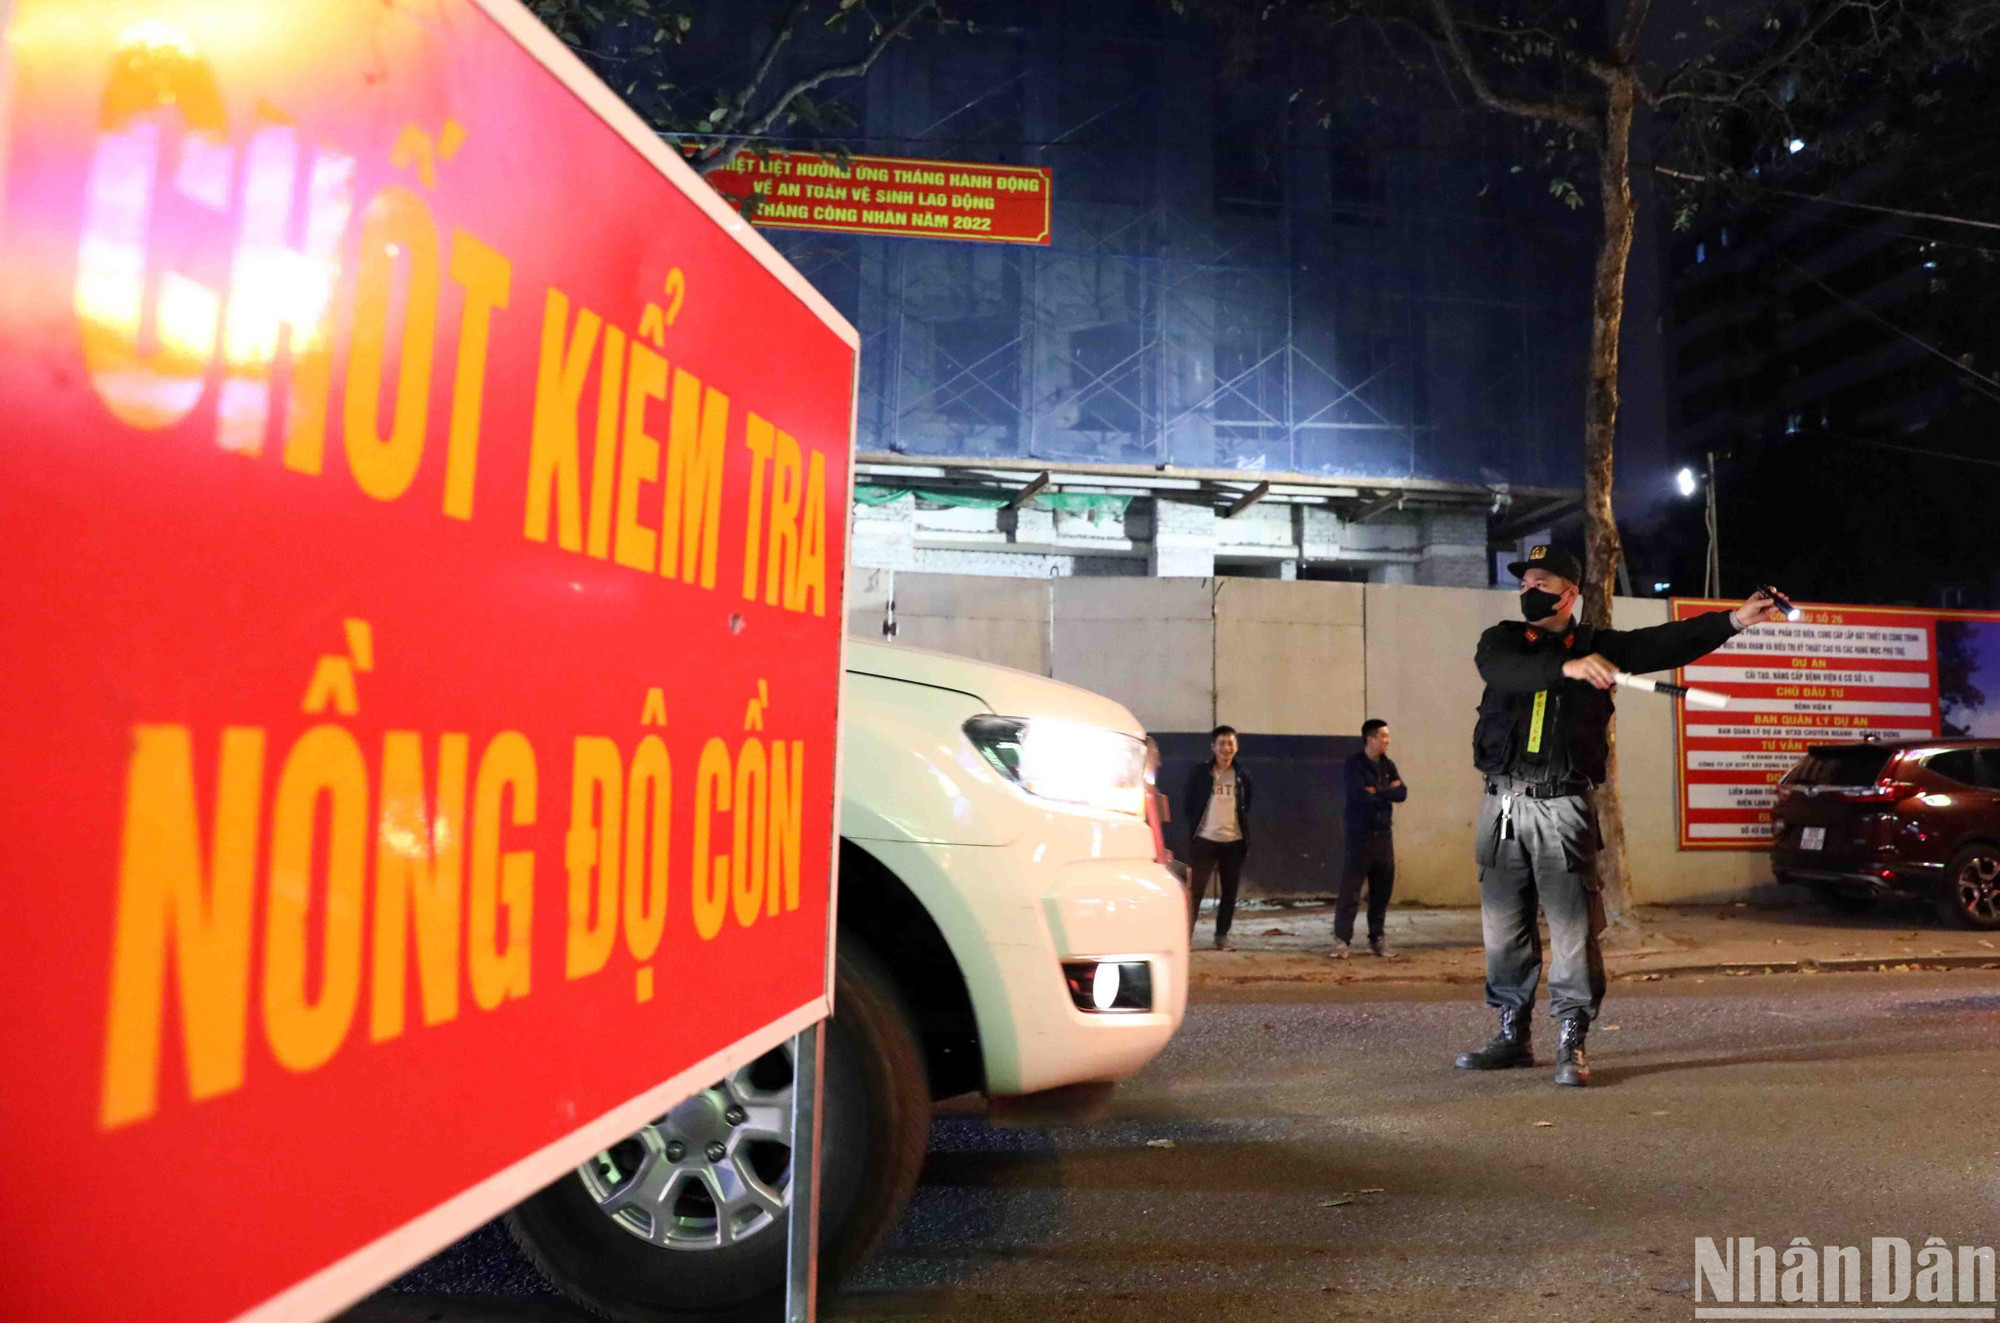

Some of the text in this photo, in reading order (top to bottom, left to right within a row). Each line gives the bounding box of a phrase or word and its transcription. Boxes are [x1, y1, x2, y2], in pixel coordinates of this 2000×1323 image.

[721, 156, 755, 174] HIỆT
[760, 158, 791, 177] LIỆT
[856, 165, 888, 182] ỨNG
[893, 168, 944, 185] THÁNG
[949, 173, 992, 188] HÀNH
[997, 176, 1039, 192] ĐỘNG
[754, 179, 773, 195] VỀ
[777, 183, 801, 197] AN
[806, 183, 847, 200] TOÀN
[852, 186, 871, 203] VỆ
[876, 190, 913, 204] SINH
[918, 192, 947, 206] LAO
[758, 202, 992, 230] THÁNG CÔNG NHÂN NĂM 2022
[74, 28, 826, 617] CHỐT KIỂM TRA
[1776, 685, 1799, 697] CHỦ
[1803, 686, 1826, 698] ĐẦU
[1754, 714, 1777, 725] BAN
[1782, 714, 1812, 725] QUẢN
[1816, 715, 1829, 726] LÝ
[100, 618, 804, 1132] NỒNG ĐỘ CỒN
